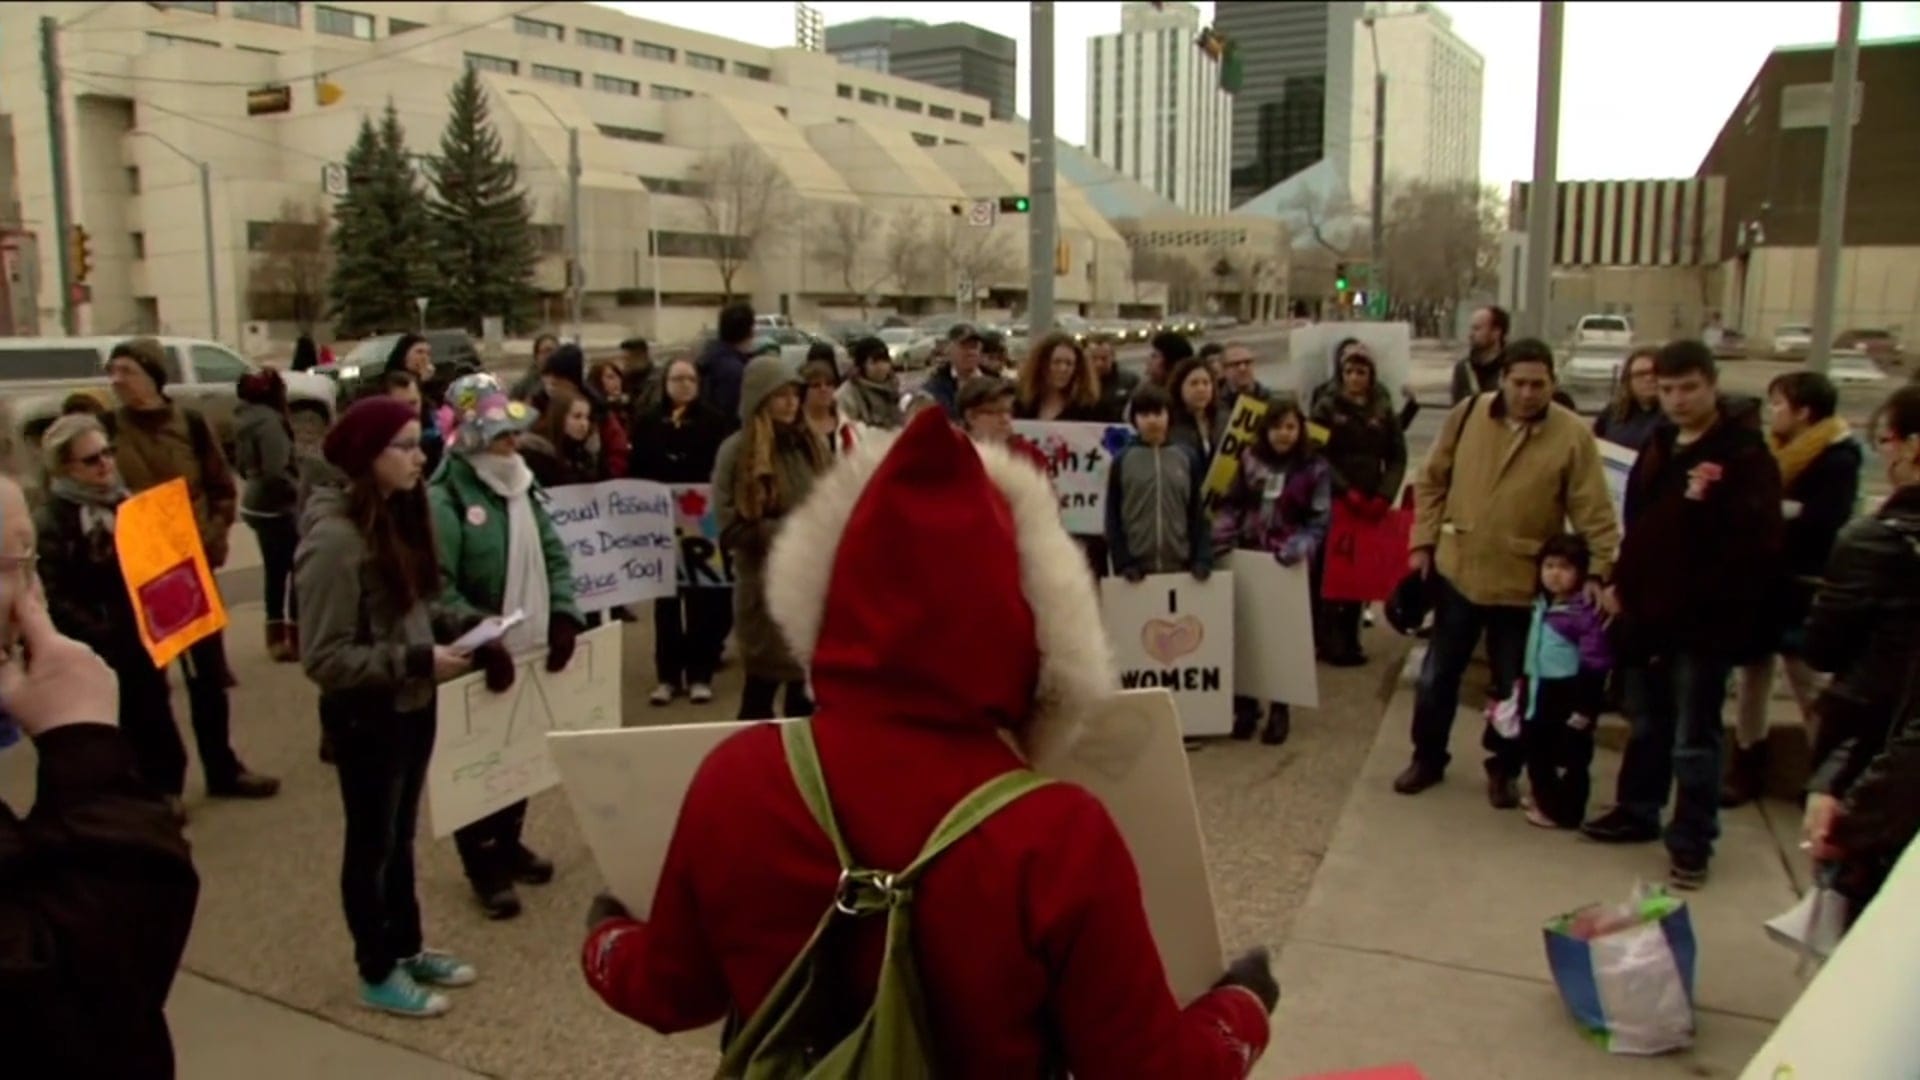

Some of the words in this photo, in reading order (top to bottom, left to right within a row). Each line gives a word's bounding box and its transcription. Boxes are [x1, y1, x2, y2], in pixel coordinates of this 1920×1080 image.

[549, 497, 600, 526] exual
[608, 490, 669, 518] Assault
[621, 557, 664, 584] Too!
[1168, 588, 1177, 614] I
[1121, 666, 1220, 692] WOMEN
